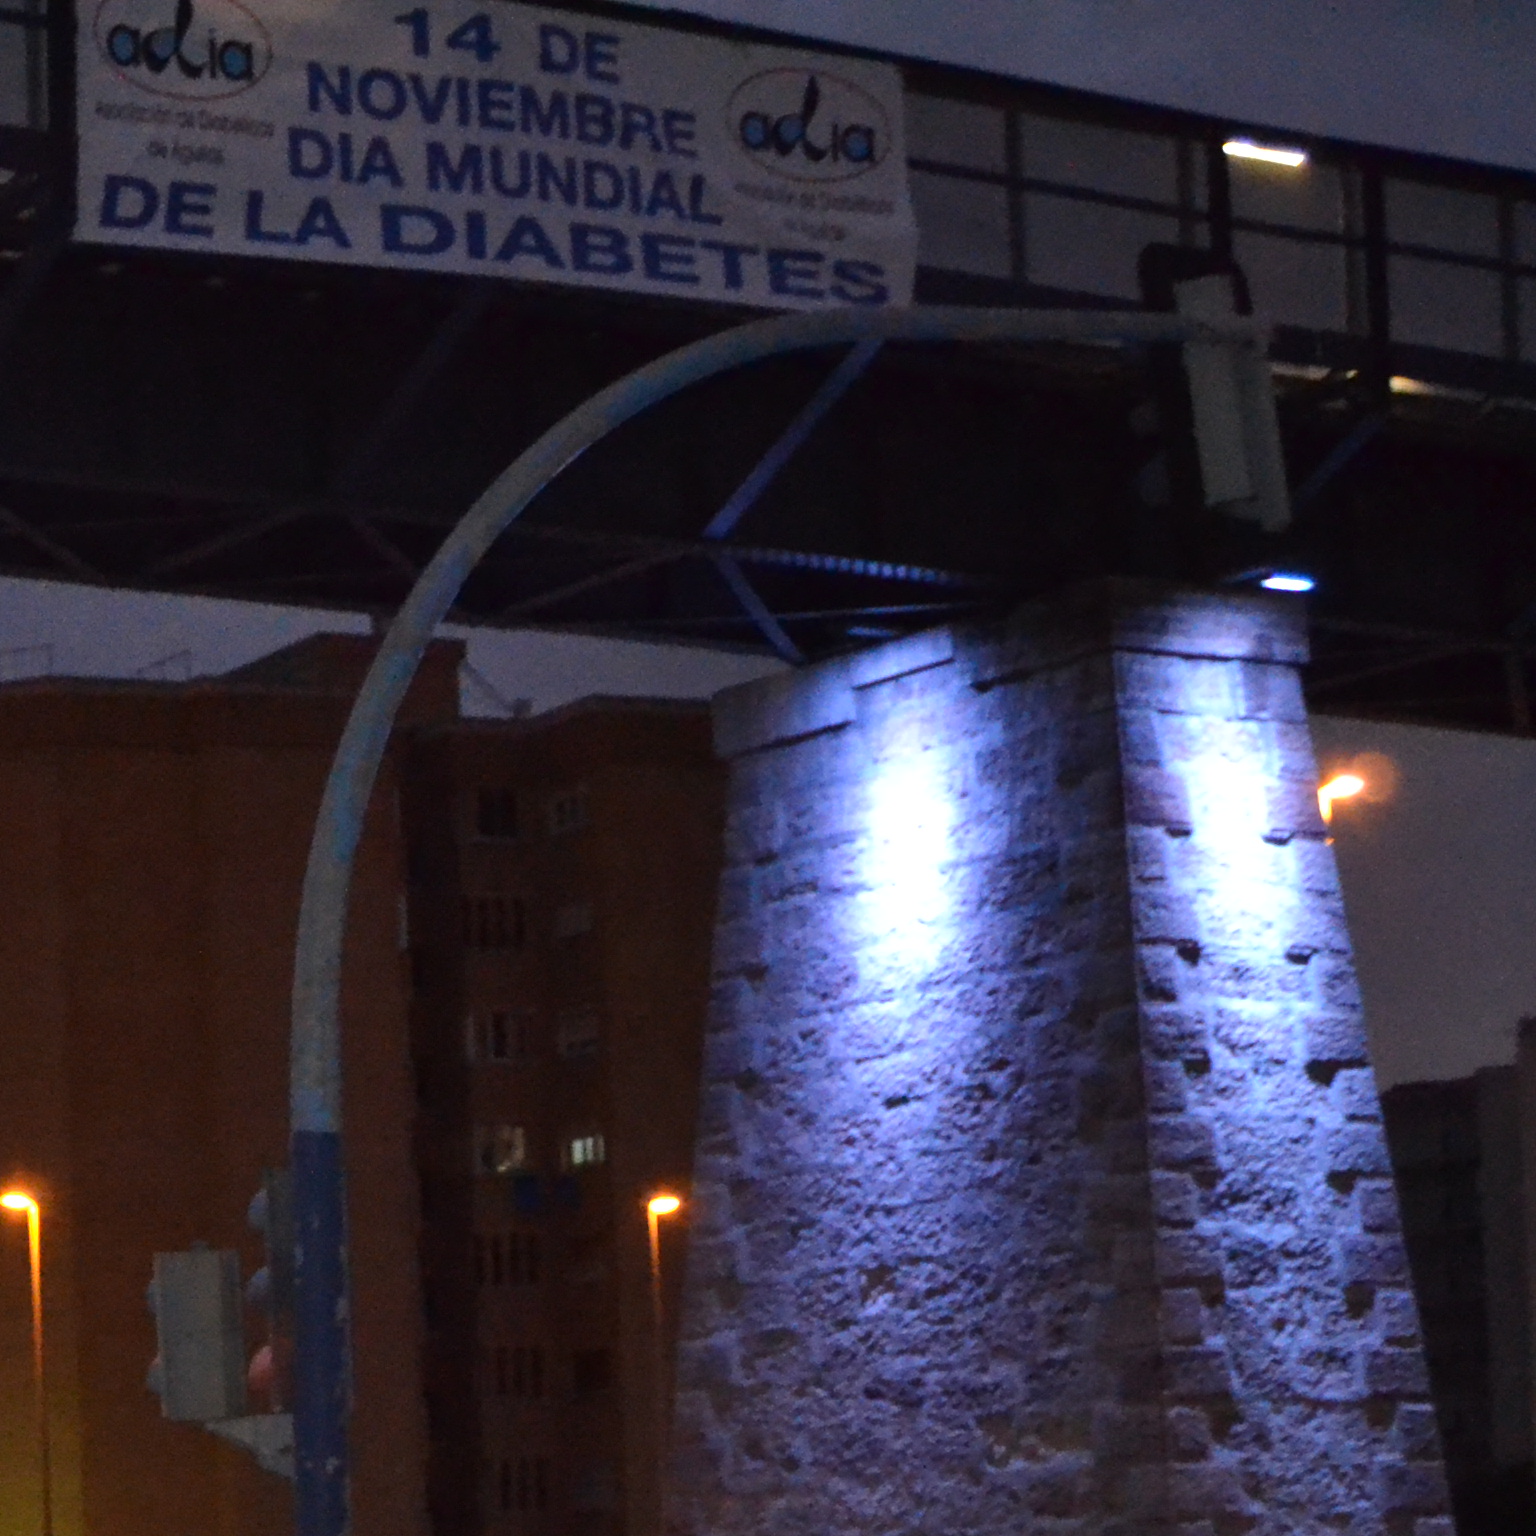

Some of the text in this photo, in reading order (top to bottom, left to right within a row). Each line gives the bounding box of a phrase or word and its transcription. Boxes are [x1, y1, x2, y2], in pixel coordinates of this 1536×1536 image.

[397, 9, 621, 82] 14 DE
[306, 62, 698, 158] NOVIEMBRE
[288, 127, 405, 188] DIA
[426, 141, 724, 226] MUNDIAL
[99, 175, 890, 305] DE LA DIABETES
